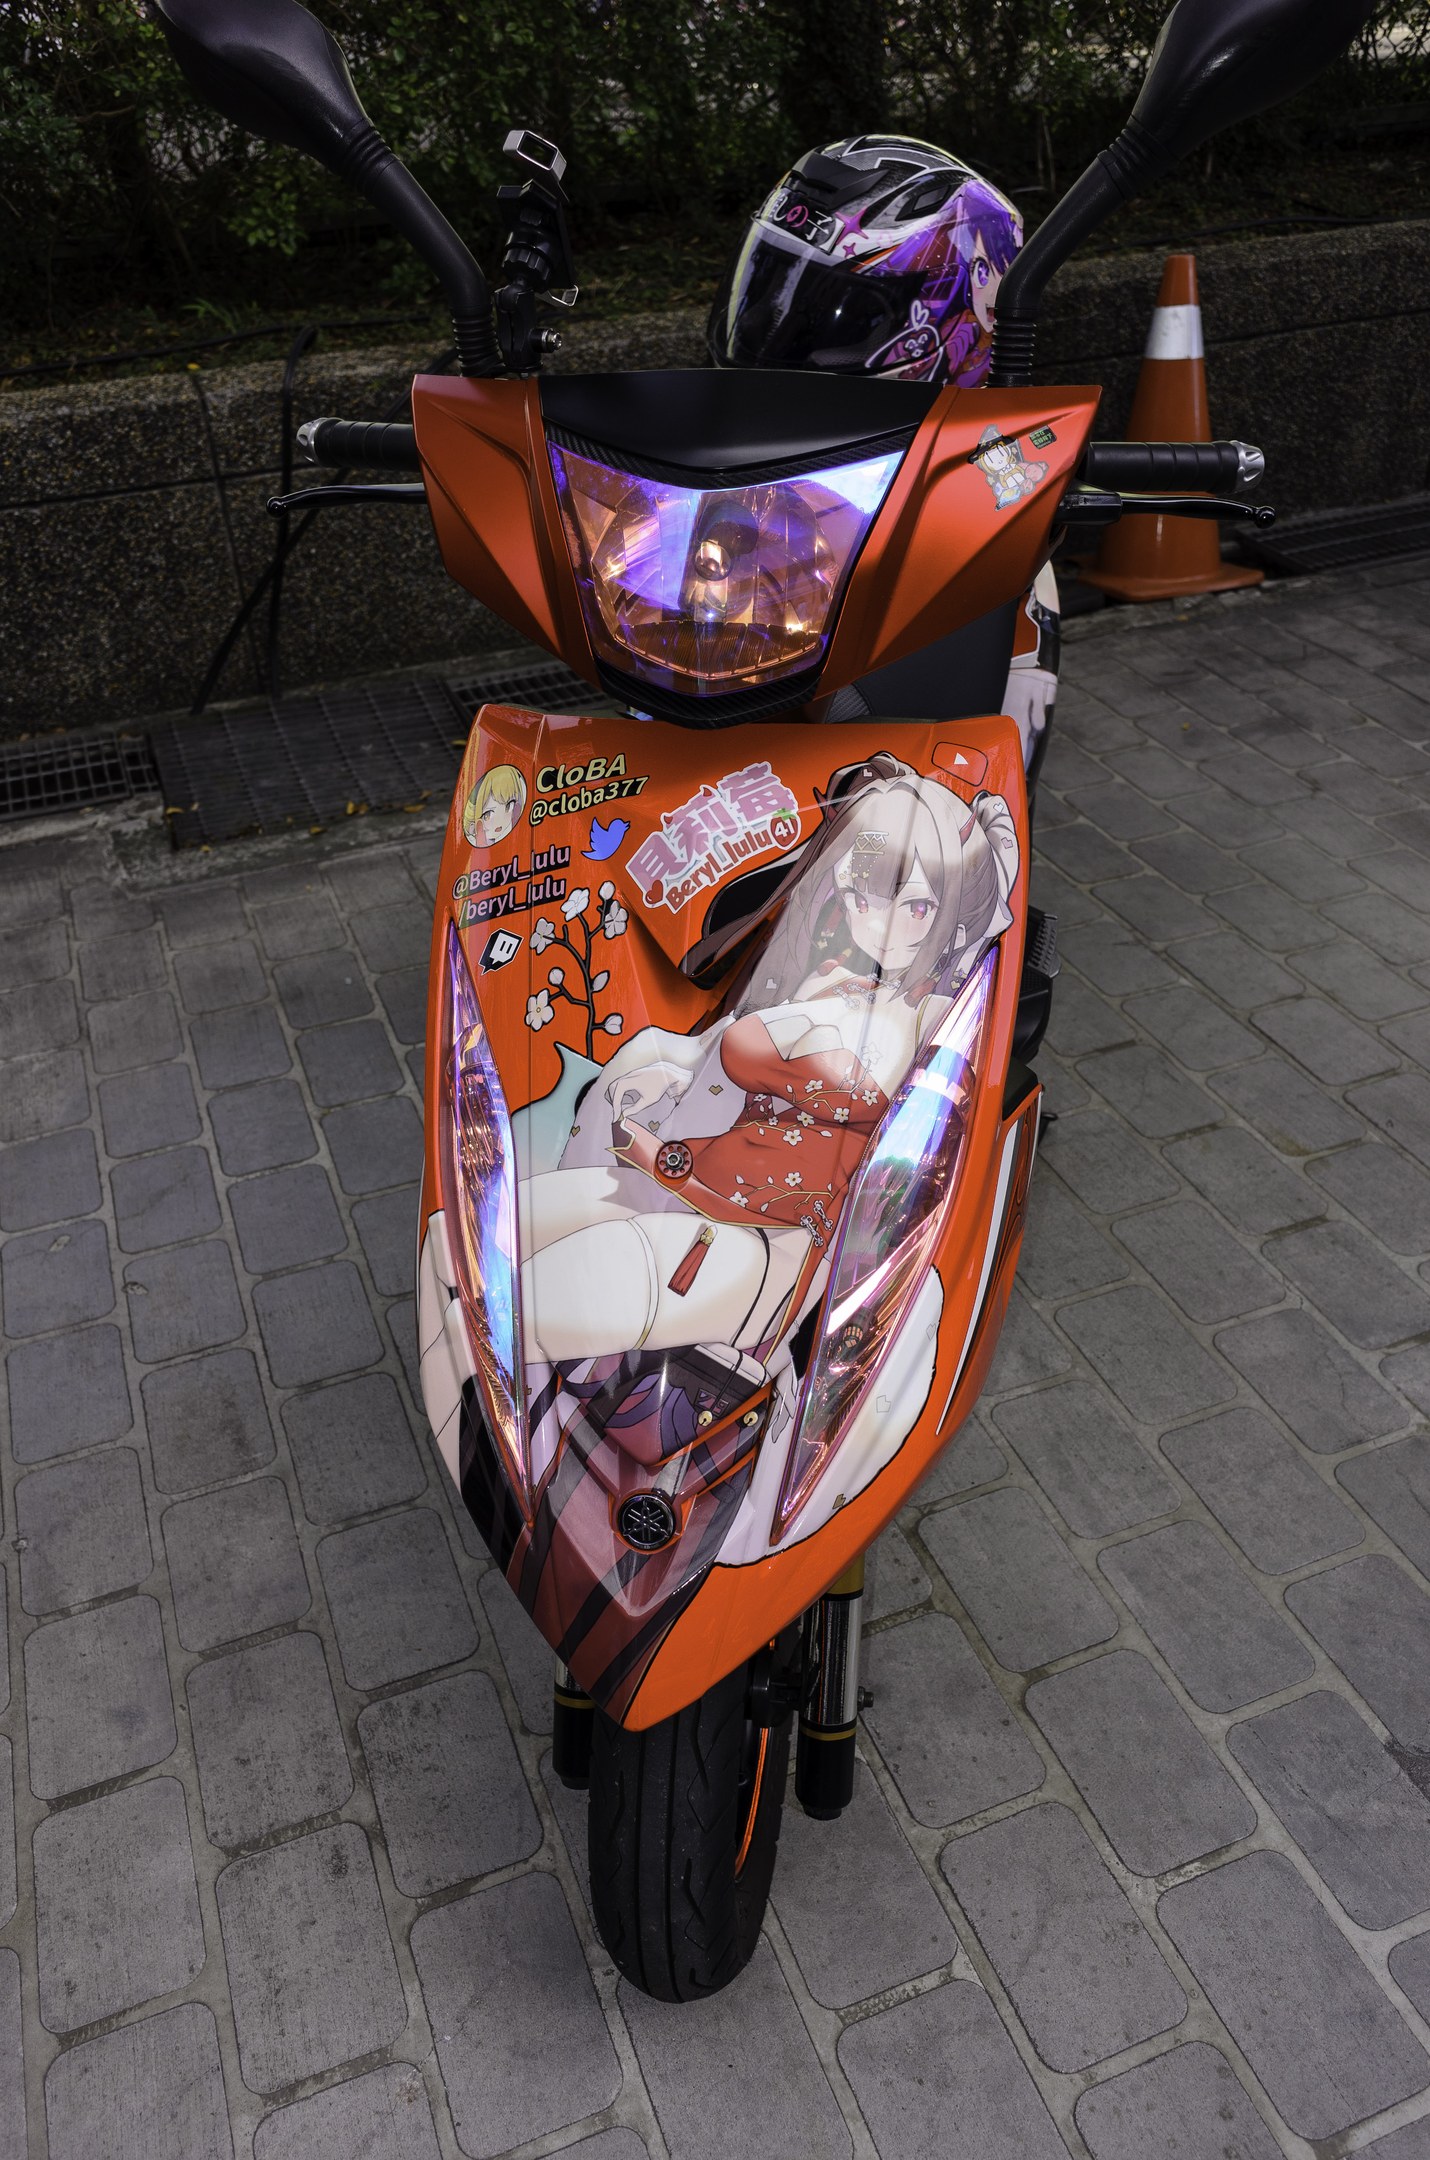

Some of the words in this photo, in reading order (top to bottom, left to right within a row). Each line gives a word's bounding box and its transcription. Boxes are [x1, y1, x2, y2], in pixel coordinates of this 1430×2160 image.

[536, 754, 626, 793] CloBA
[530, 776, 649, 825] @cloba377
[453, 845, 570, 900] @Beryl_lulu
[665, 829, 773, 911] Beryl_lulu
[774, 819, 794, 838] 41
[458, 877, 566, 928] /beryl_lulu
